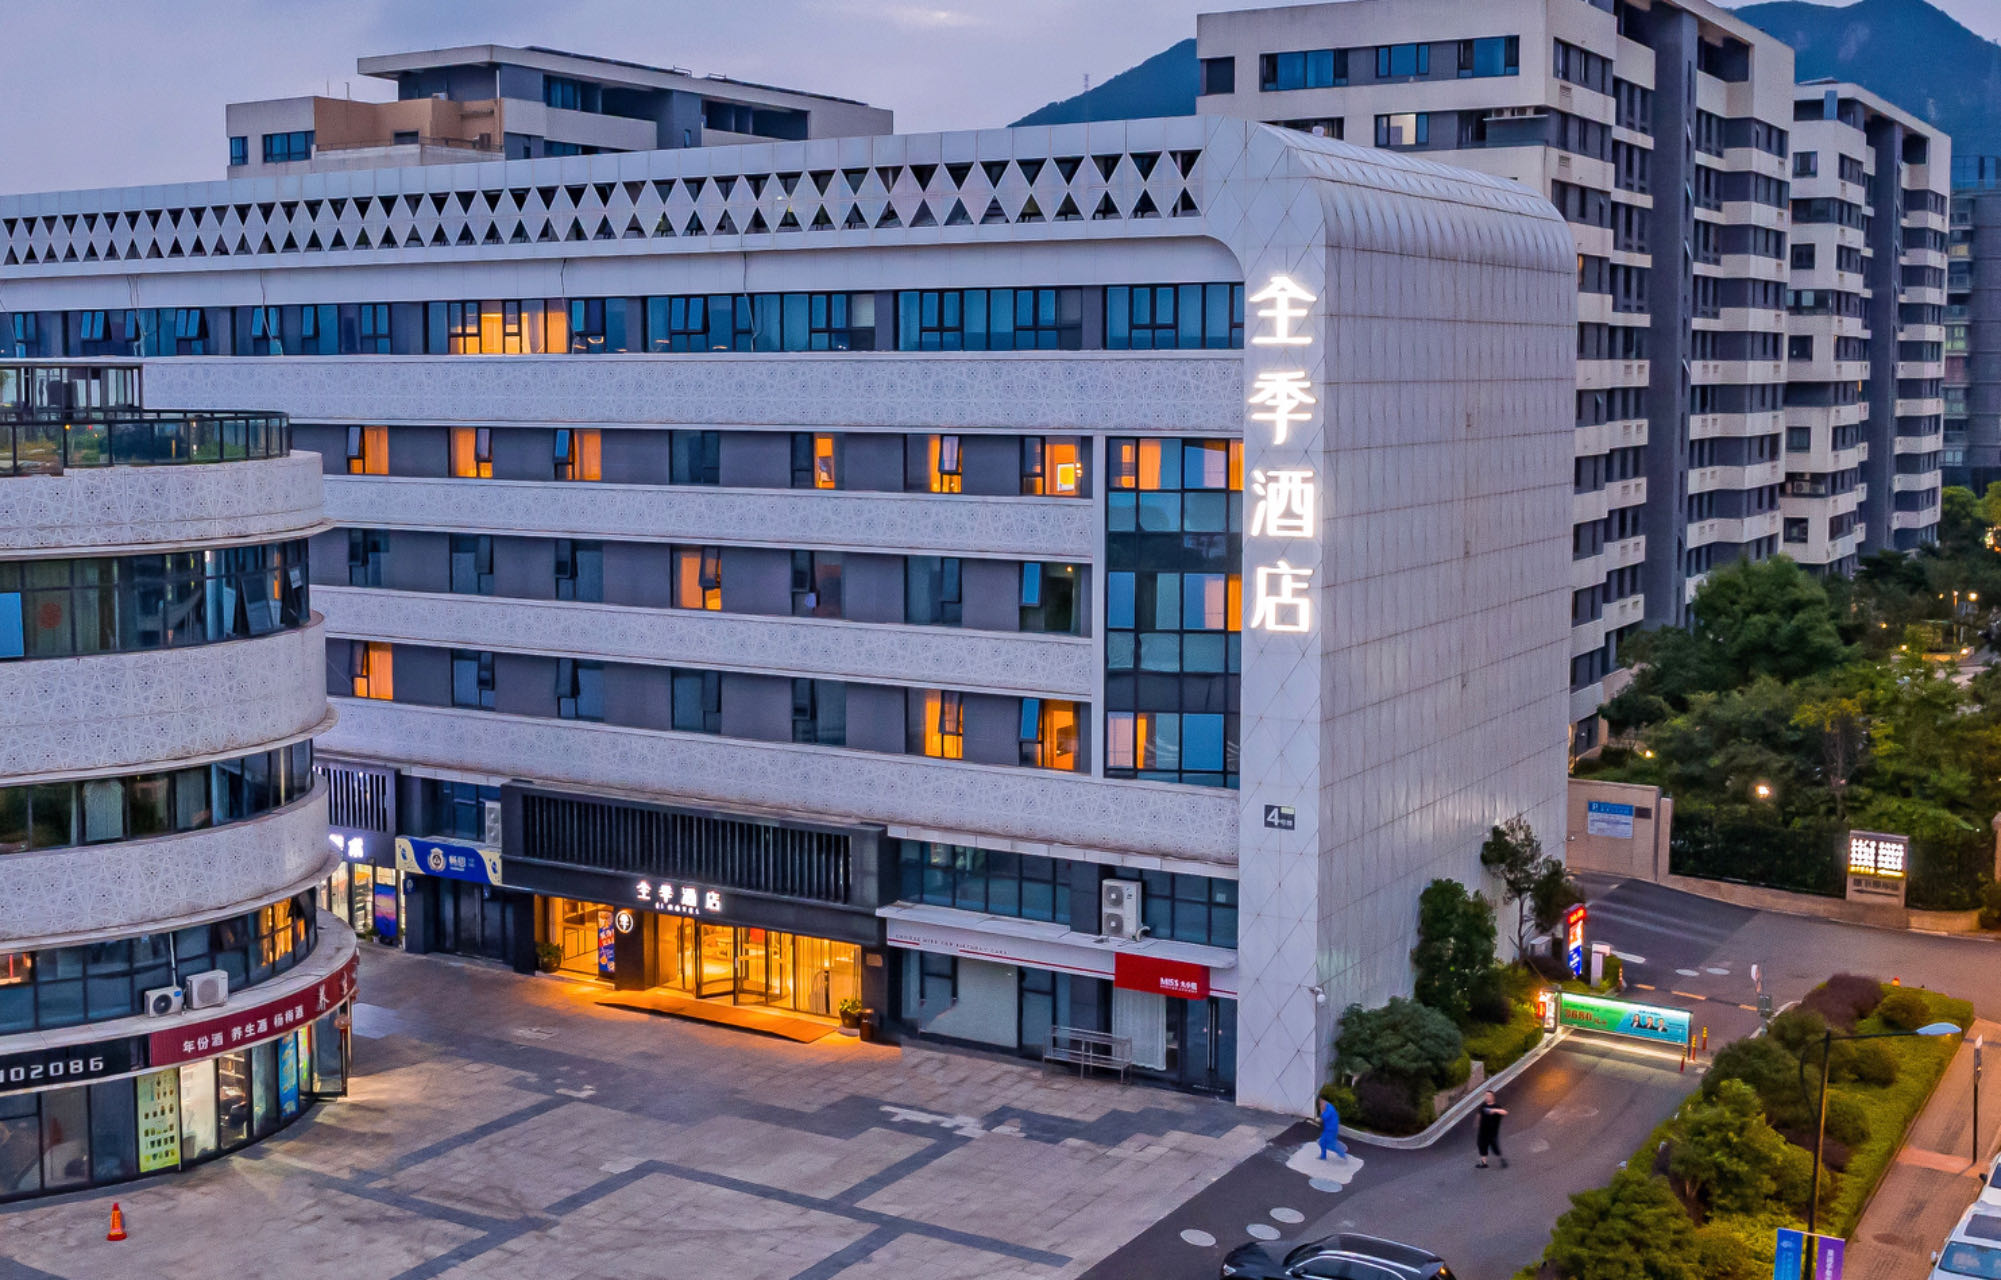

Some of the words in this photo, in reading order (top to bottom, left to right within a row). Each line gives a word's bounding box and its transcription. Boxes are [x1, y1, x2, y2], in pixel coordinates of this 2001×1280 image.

[1248, 276, 1317, 633] 全季酒店
[636, 880, 721, 911] 全季酒店
[1160, 976, 1179, 987] MISS
[183, 1032, 224, 1053] 年份酒
[231, 1018, 268, 1042] 养生酒
